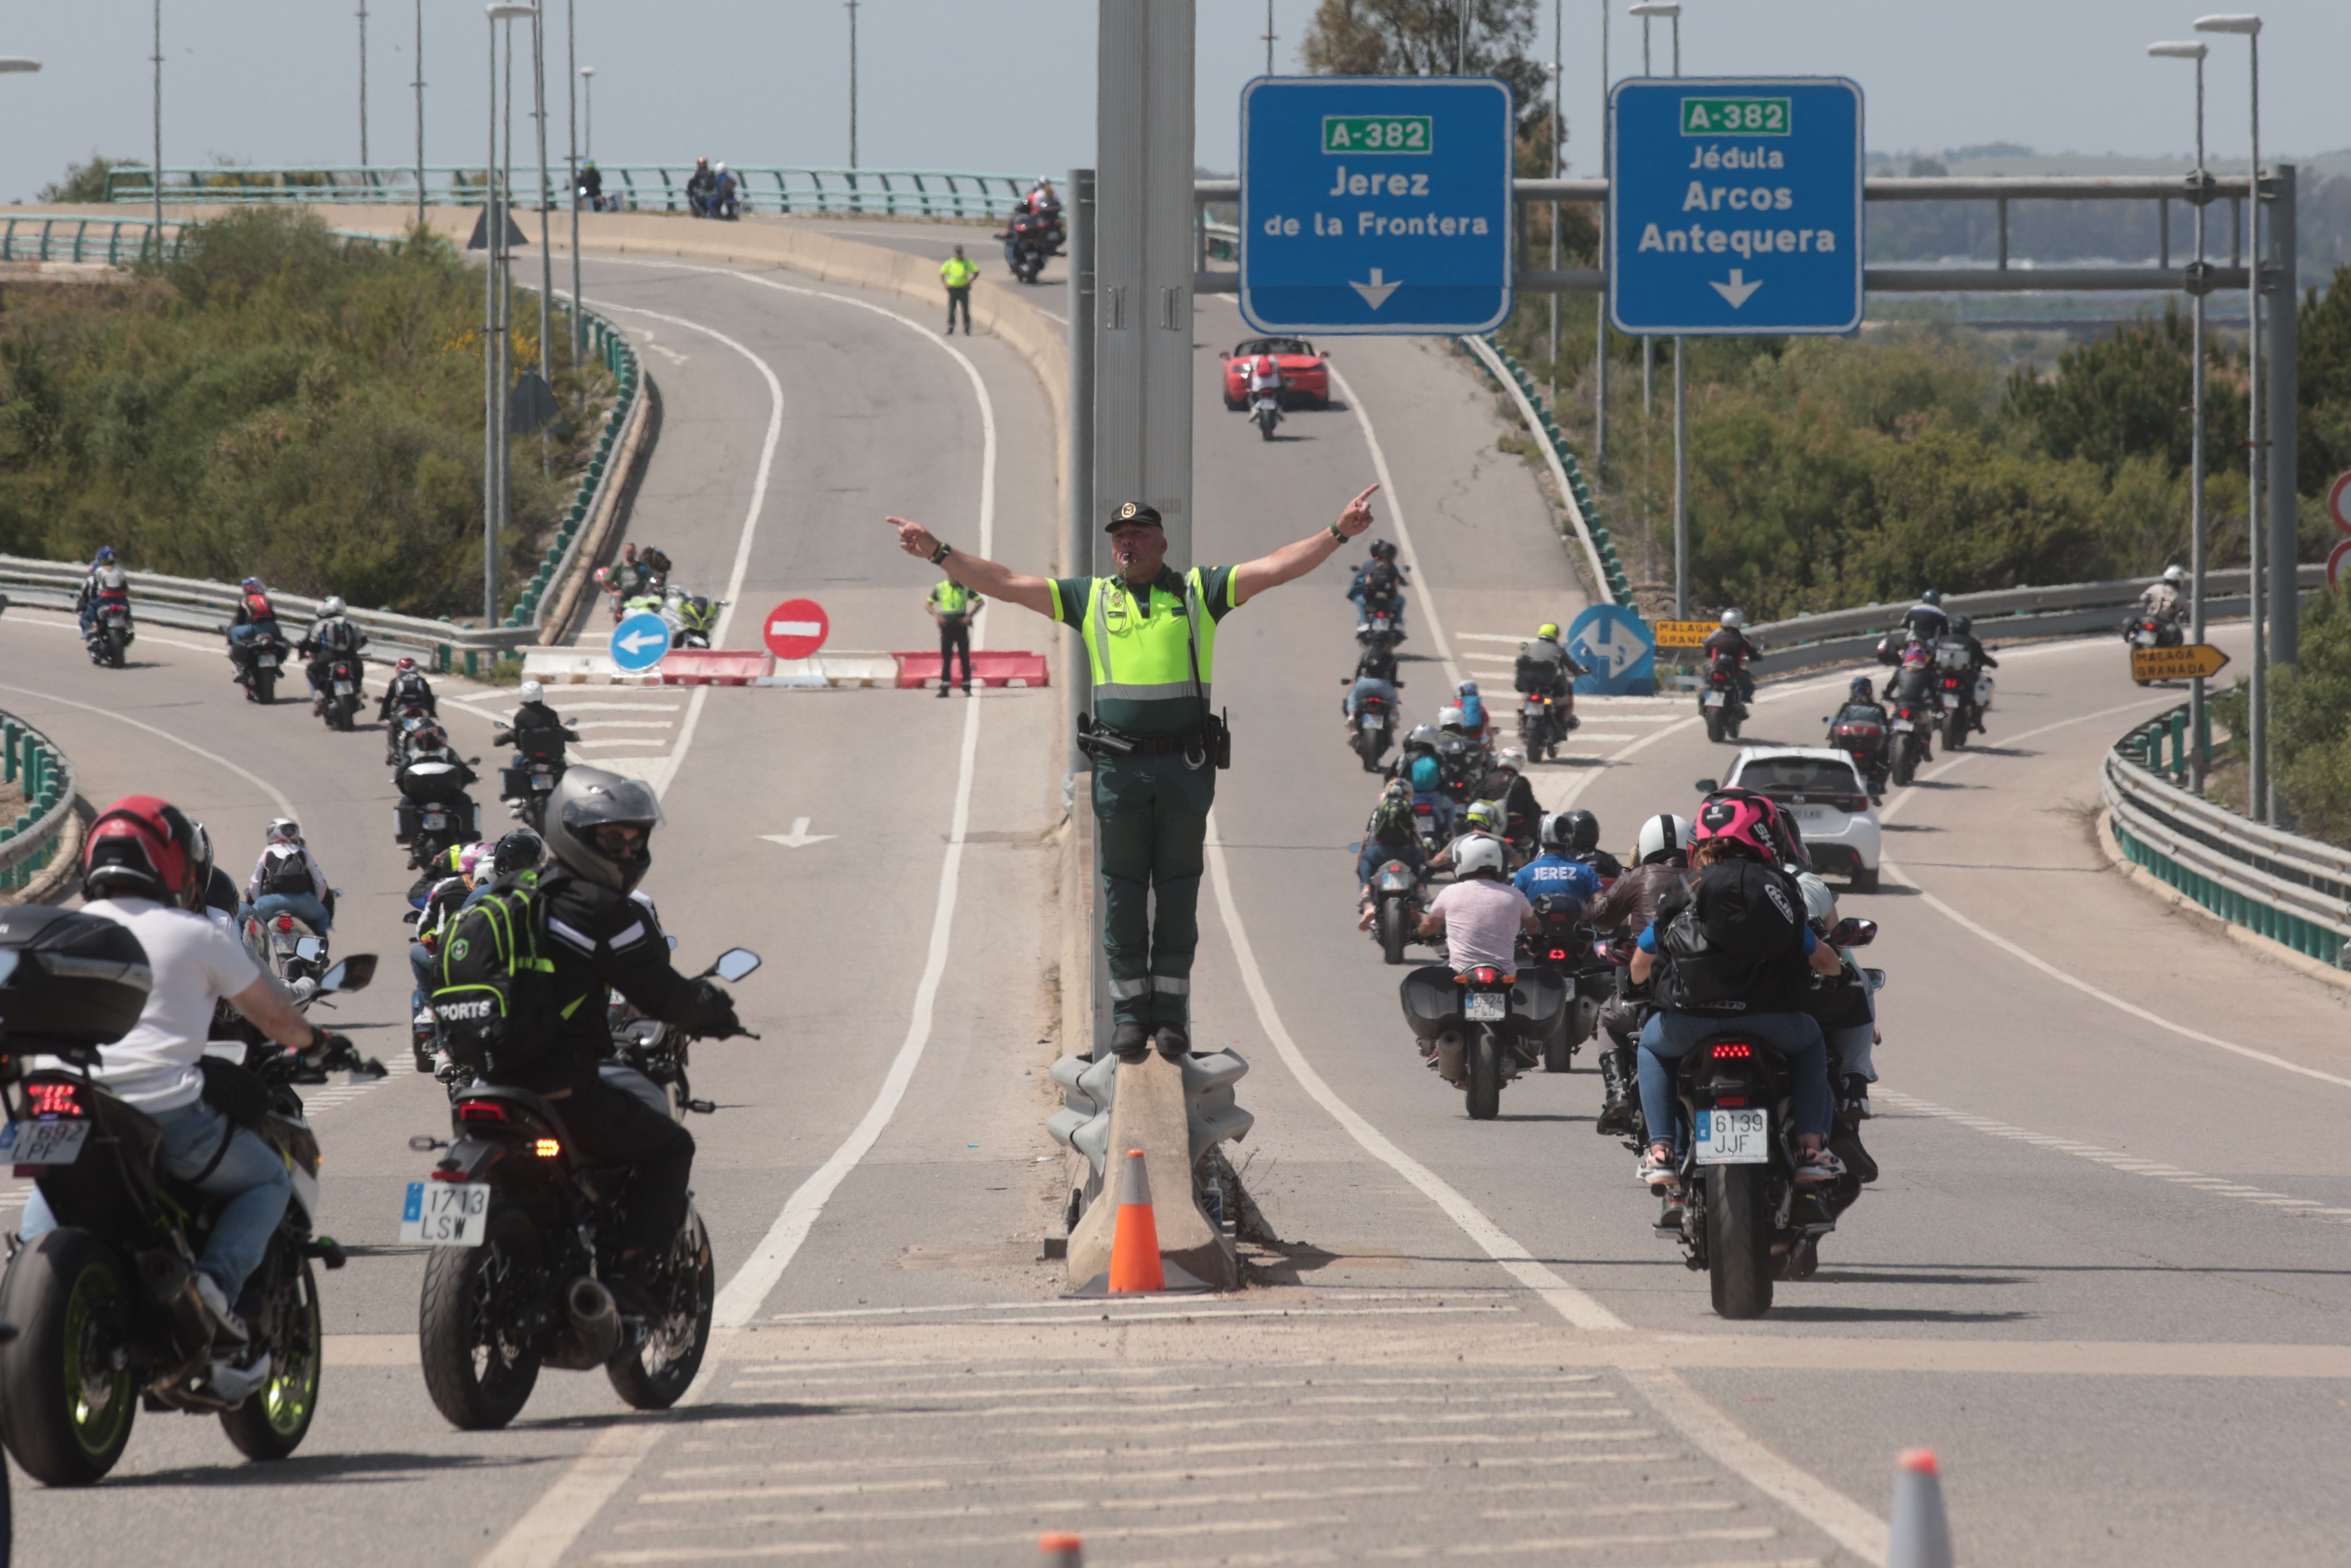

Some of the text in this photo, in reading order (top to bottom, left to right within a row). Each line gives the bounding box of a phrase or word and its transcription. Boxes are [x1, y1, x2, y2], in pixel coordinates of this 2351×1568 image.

[1689, 105, 1783, 130] A-382
[1331, 122, 1425, 148] A-382
[1690, 145, 1784, 169] Jédula
[1330, 166, 1429, 196] Jerez
[1682, 181, 1792, 212] Arcos
[1264, 212, 1488, 236] de la Frontera
[1638, 223, 1836, 259] Antequera
[2137, 663, 2205, 676] GRANADA
[1532, 867, 1577, 881] JEREZ
[1716, 1114, 1763, 1133] 6139
[1715, 1135, 1749, 1153] JJF
[431, 1190, 484, 1215] 1713
[421, 1215, 466, 1241] LSW
